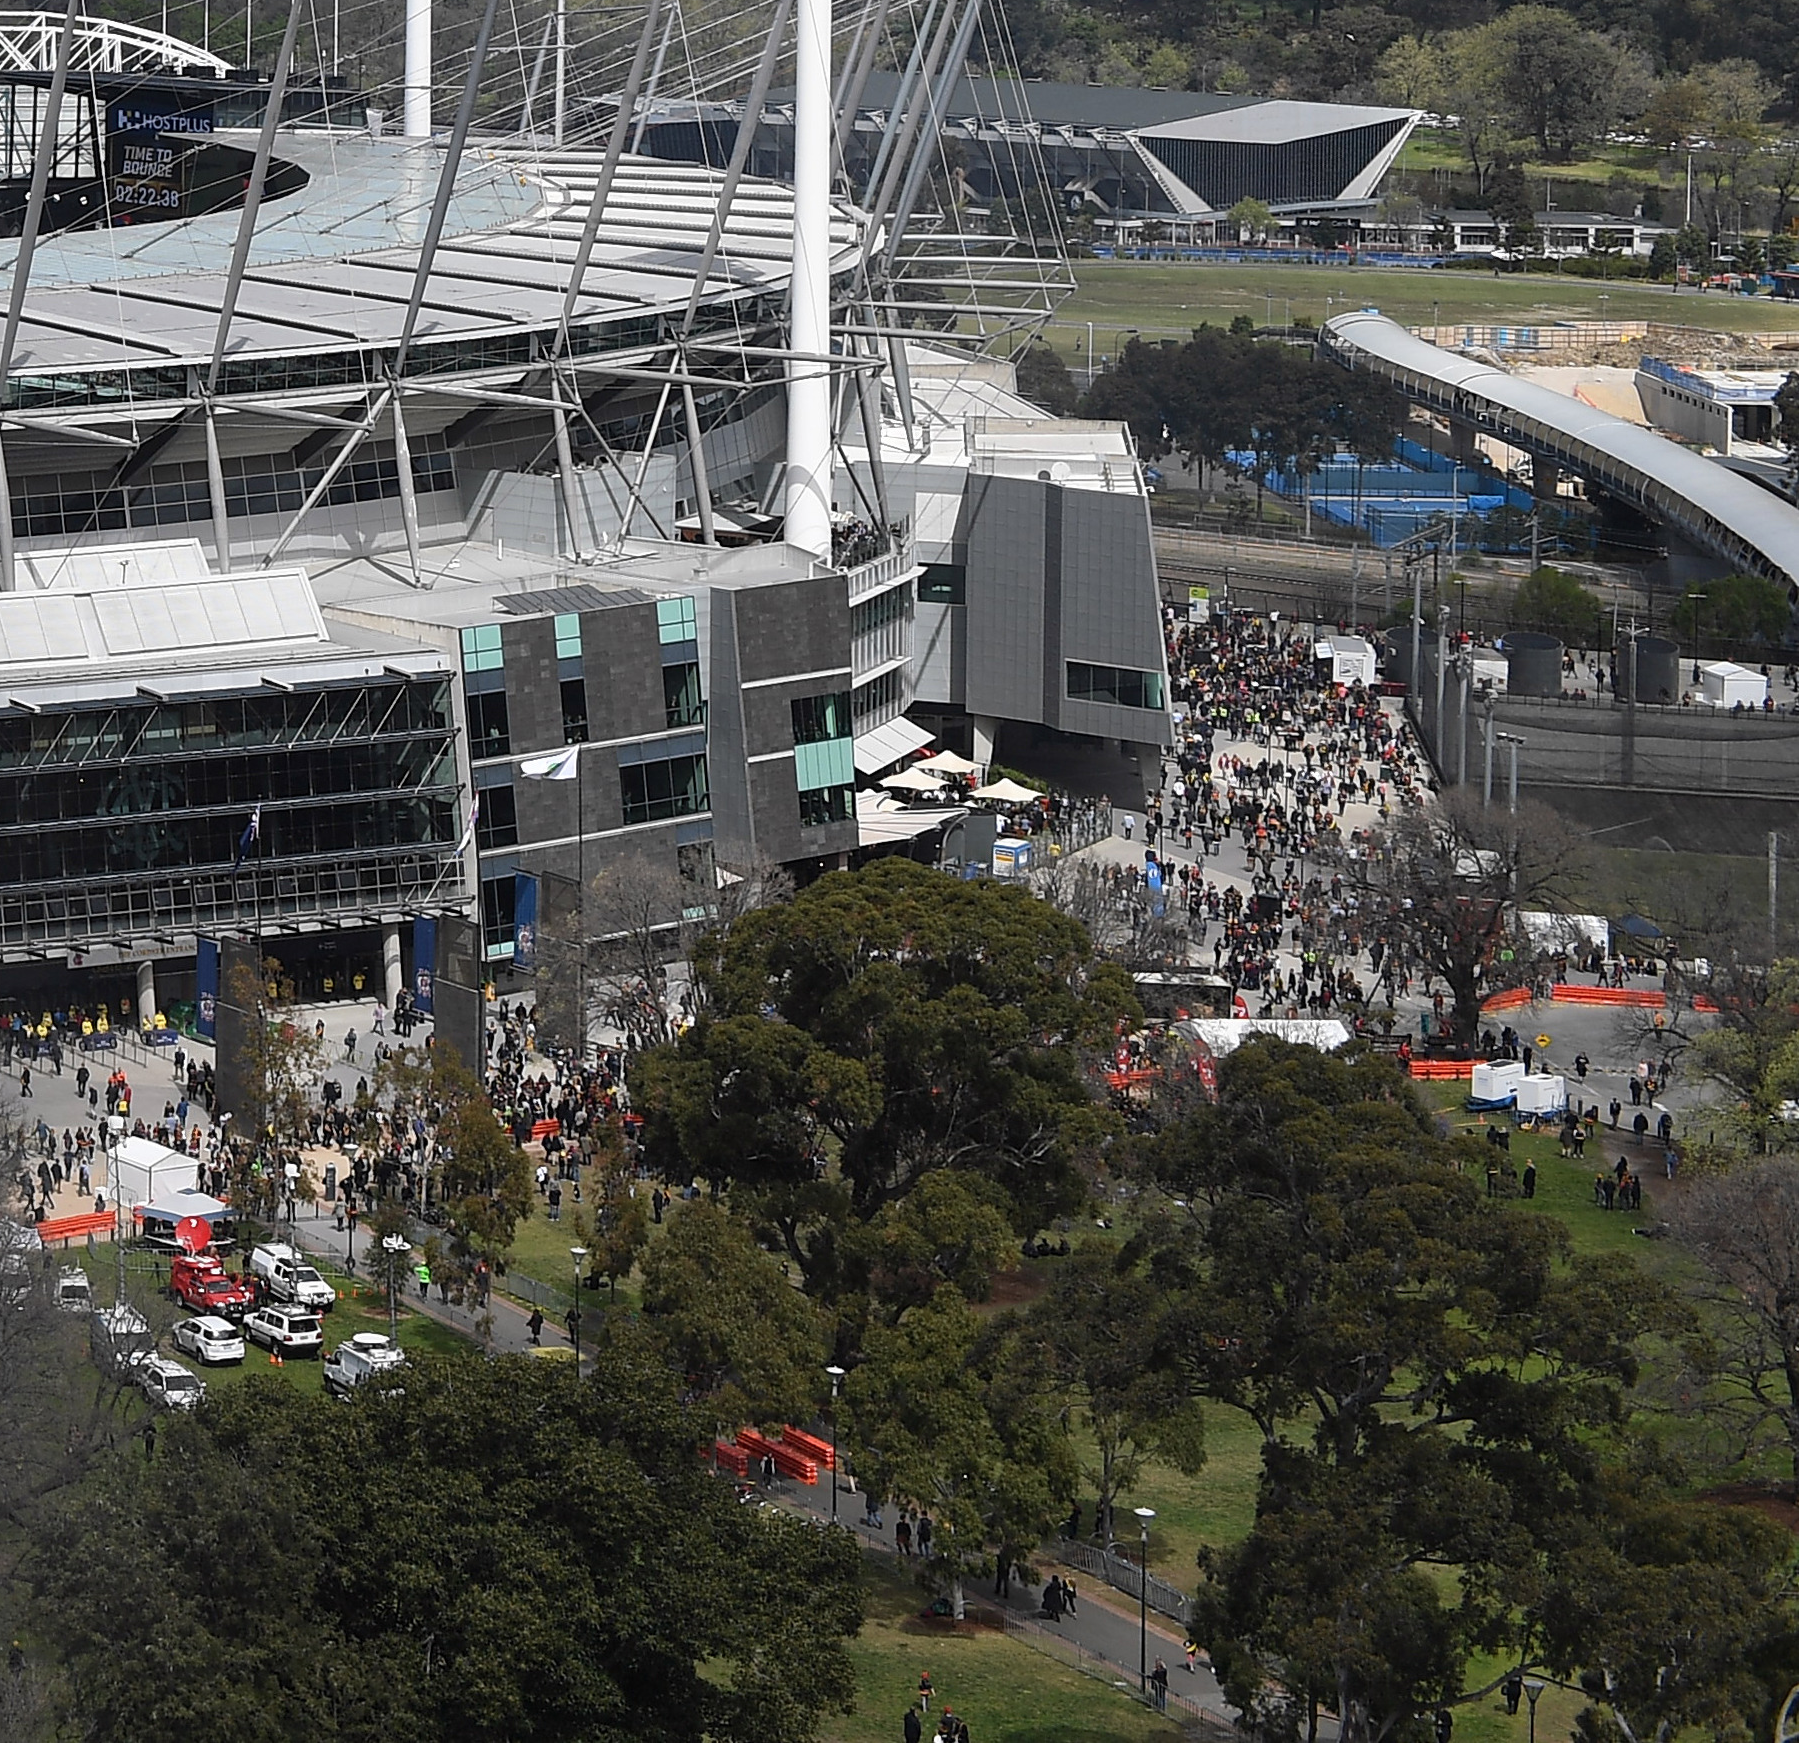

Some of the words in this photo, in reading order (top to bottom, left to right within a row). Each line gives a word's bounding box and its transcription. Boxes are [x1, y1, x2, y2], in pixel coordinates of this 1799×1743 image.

[142, 114, 211, 133] HOSTPLUS
[124, 145, 154, 161] TIME
[156, 148, 173, 163] TO
[122, 160, 173, 178] BOUNCE
[116, 184, 179, 207] 02:22:38
